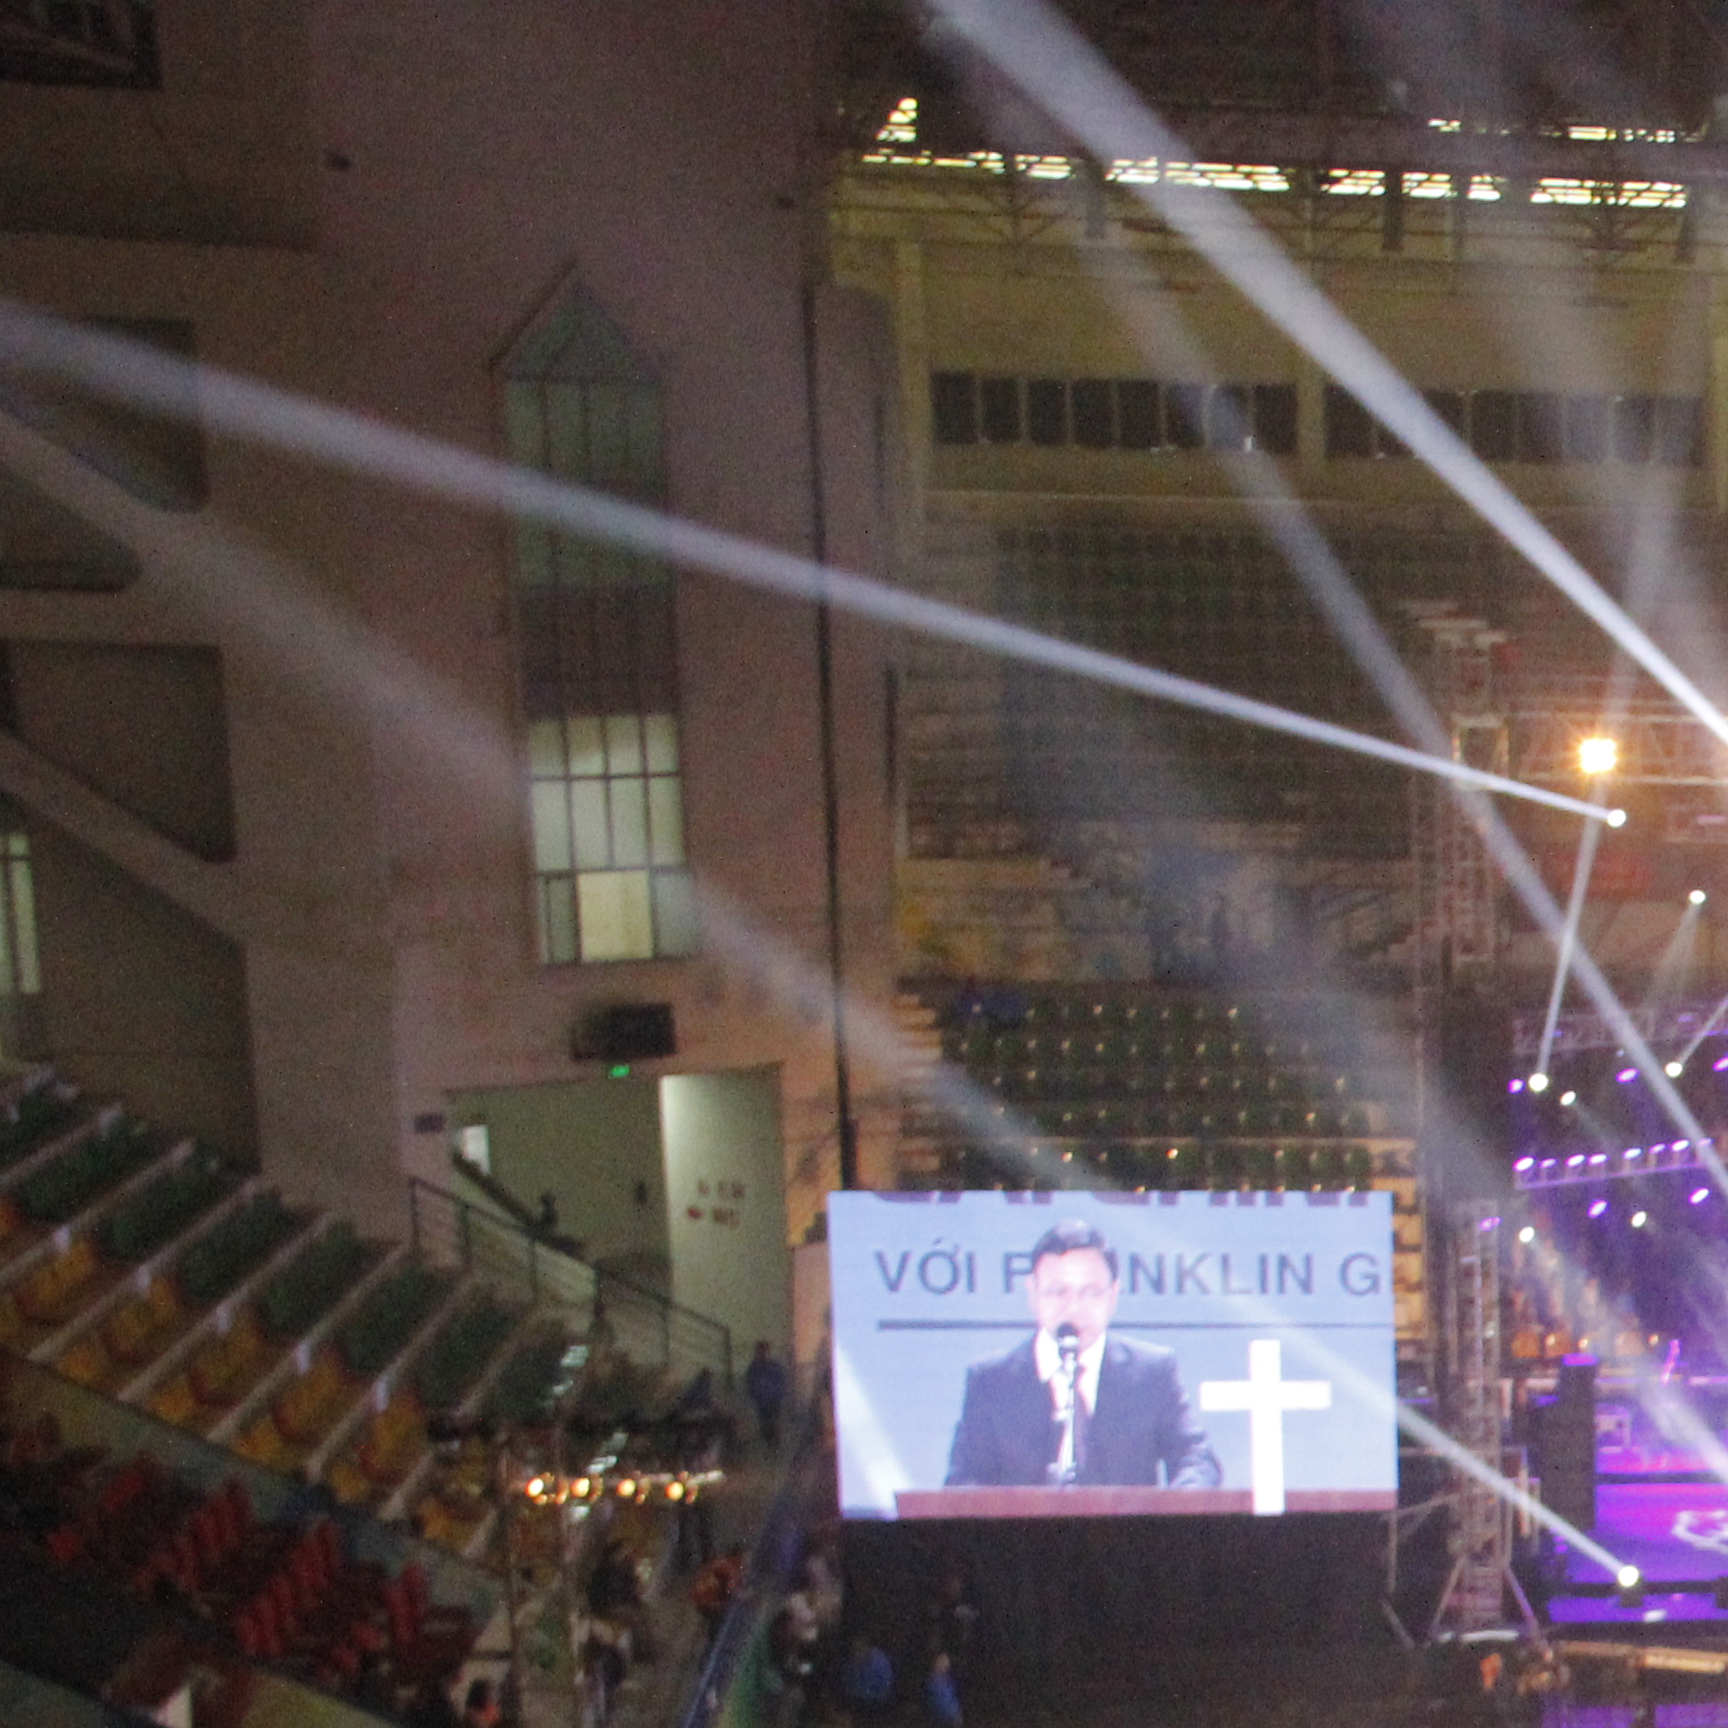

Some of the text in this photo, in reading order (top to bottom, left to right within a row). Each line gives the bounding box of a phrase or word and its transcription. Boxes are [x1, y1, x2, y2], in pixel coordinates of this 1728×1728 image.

[875, 1236, 1383, 1298] VỚI FNKLIN G
